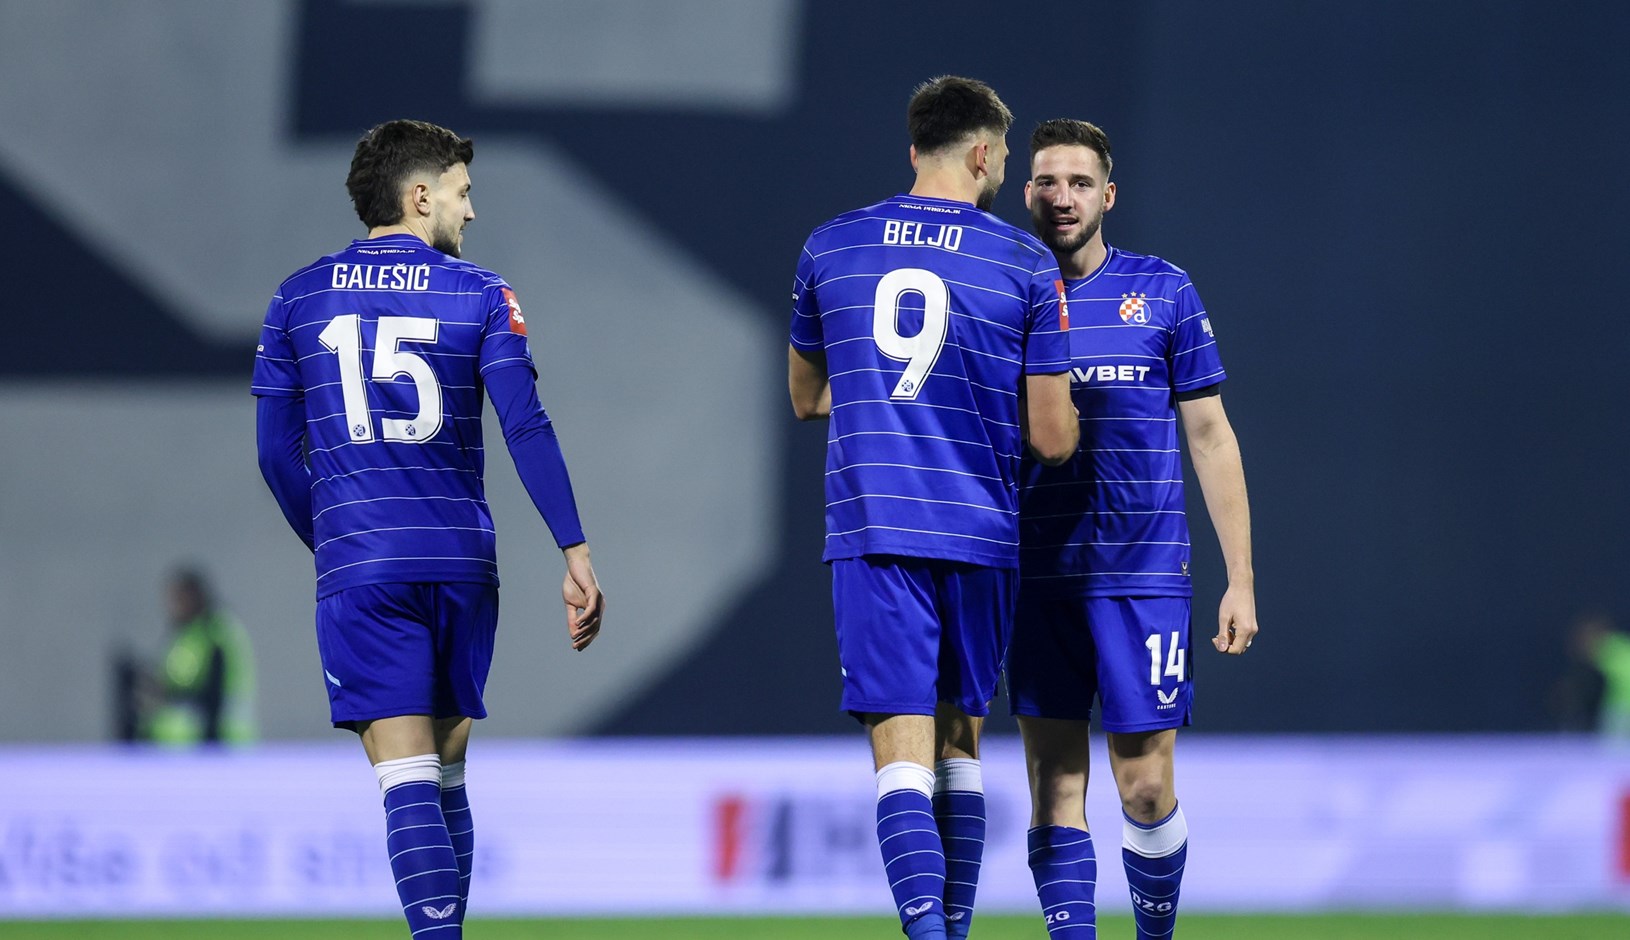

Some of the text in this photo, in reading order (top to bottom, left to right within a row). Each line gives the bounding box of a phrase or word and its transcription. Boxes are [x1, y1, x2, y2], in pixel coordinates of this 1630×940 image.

[883, 220, 963, 251] BELJO
[331, 263, 430, 291] GALEŠIĆ
[872, 268, 951, 401] 9
[318, 313, 443, 444] 15
[1145, 631, 1185, 686] 14
[1132, 891, 1172, 912] DZG
[1045, 910, 1070, 925] ZG
